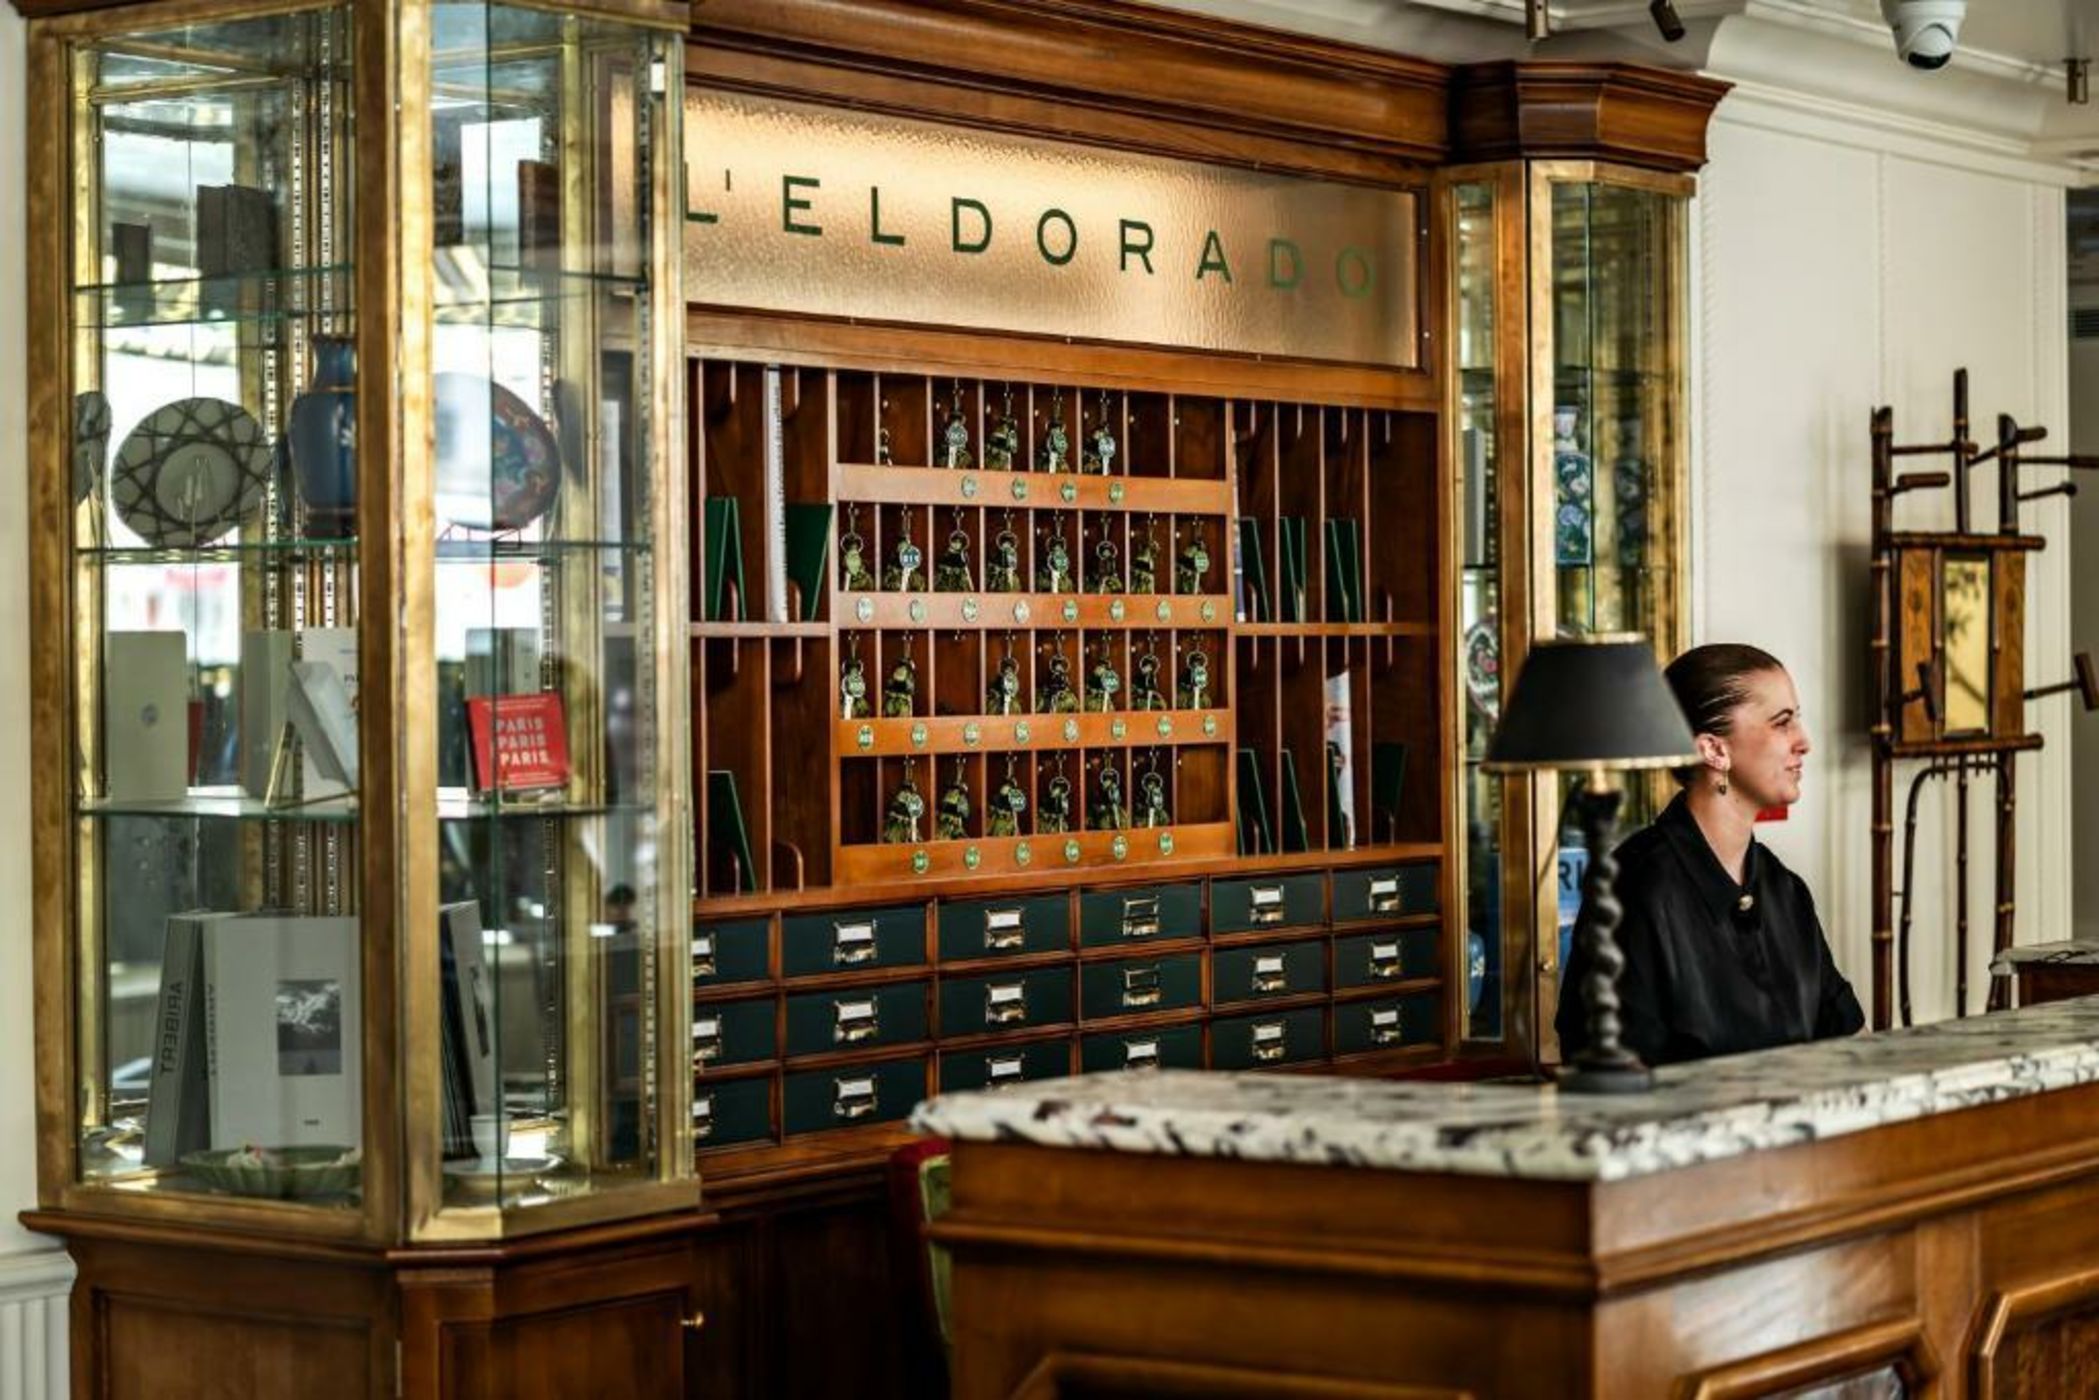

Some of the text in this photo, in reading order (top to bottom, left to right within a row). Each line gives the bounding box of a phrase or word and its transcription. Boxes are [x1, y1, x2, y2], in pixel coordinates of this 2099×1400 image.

[684, 161, 1377, 298] L'ELDORADO
[496, 717, 543, 732] PARIS
[498, 733, 546, 748] PARIS
[500, 749, 551, 765] PARIS
